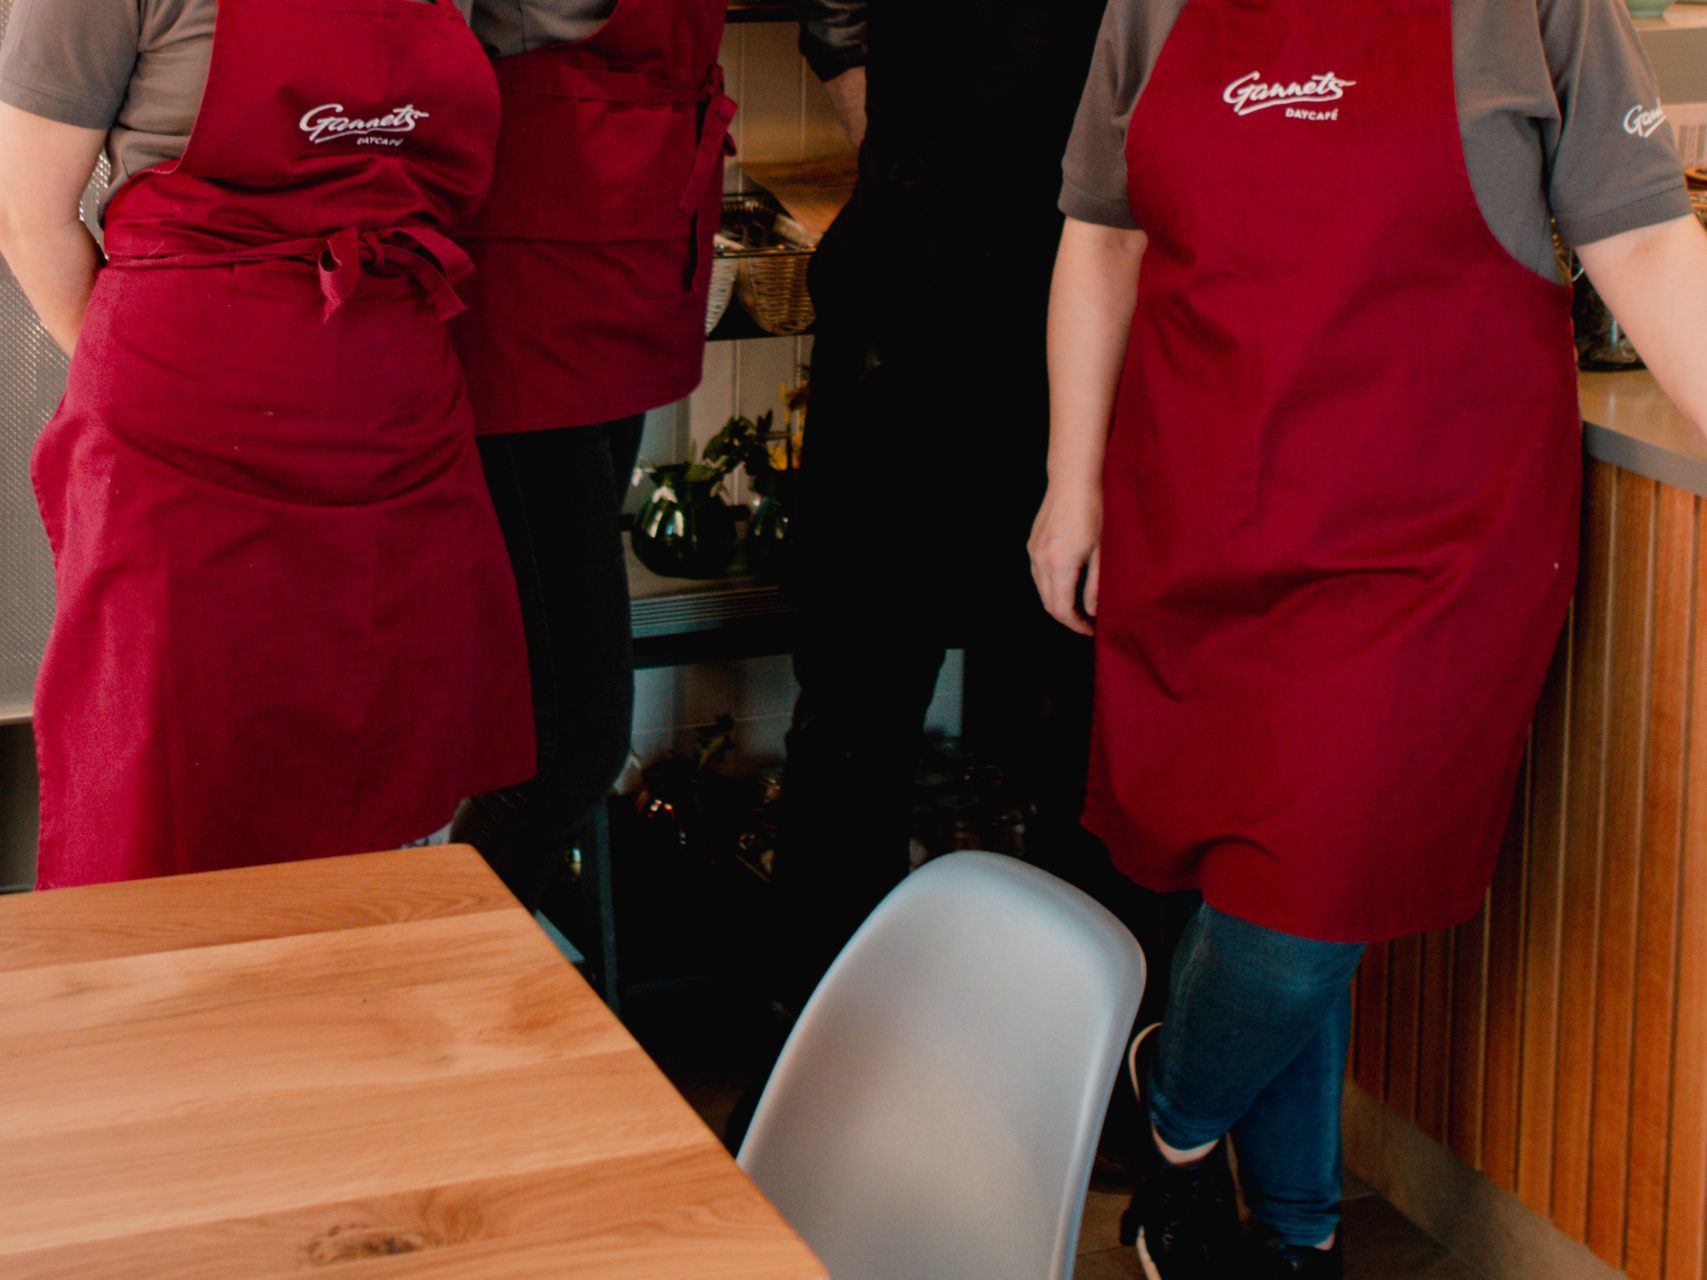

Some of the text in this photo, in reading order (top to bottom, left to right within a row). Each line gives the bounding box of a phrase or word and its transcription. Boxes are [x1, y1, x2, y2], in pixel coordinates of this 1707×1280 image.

[1223, 70, 1357, 116] Gannets
[299, 103, 429, 144] Gannets
[1284, 108, 1339, 121] DAYCAFÉ
